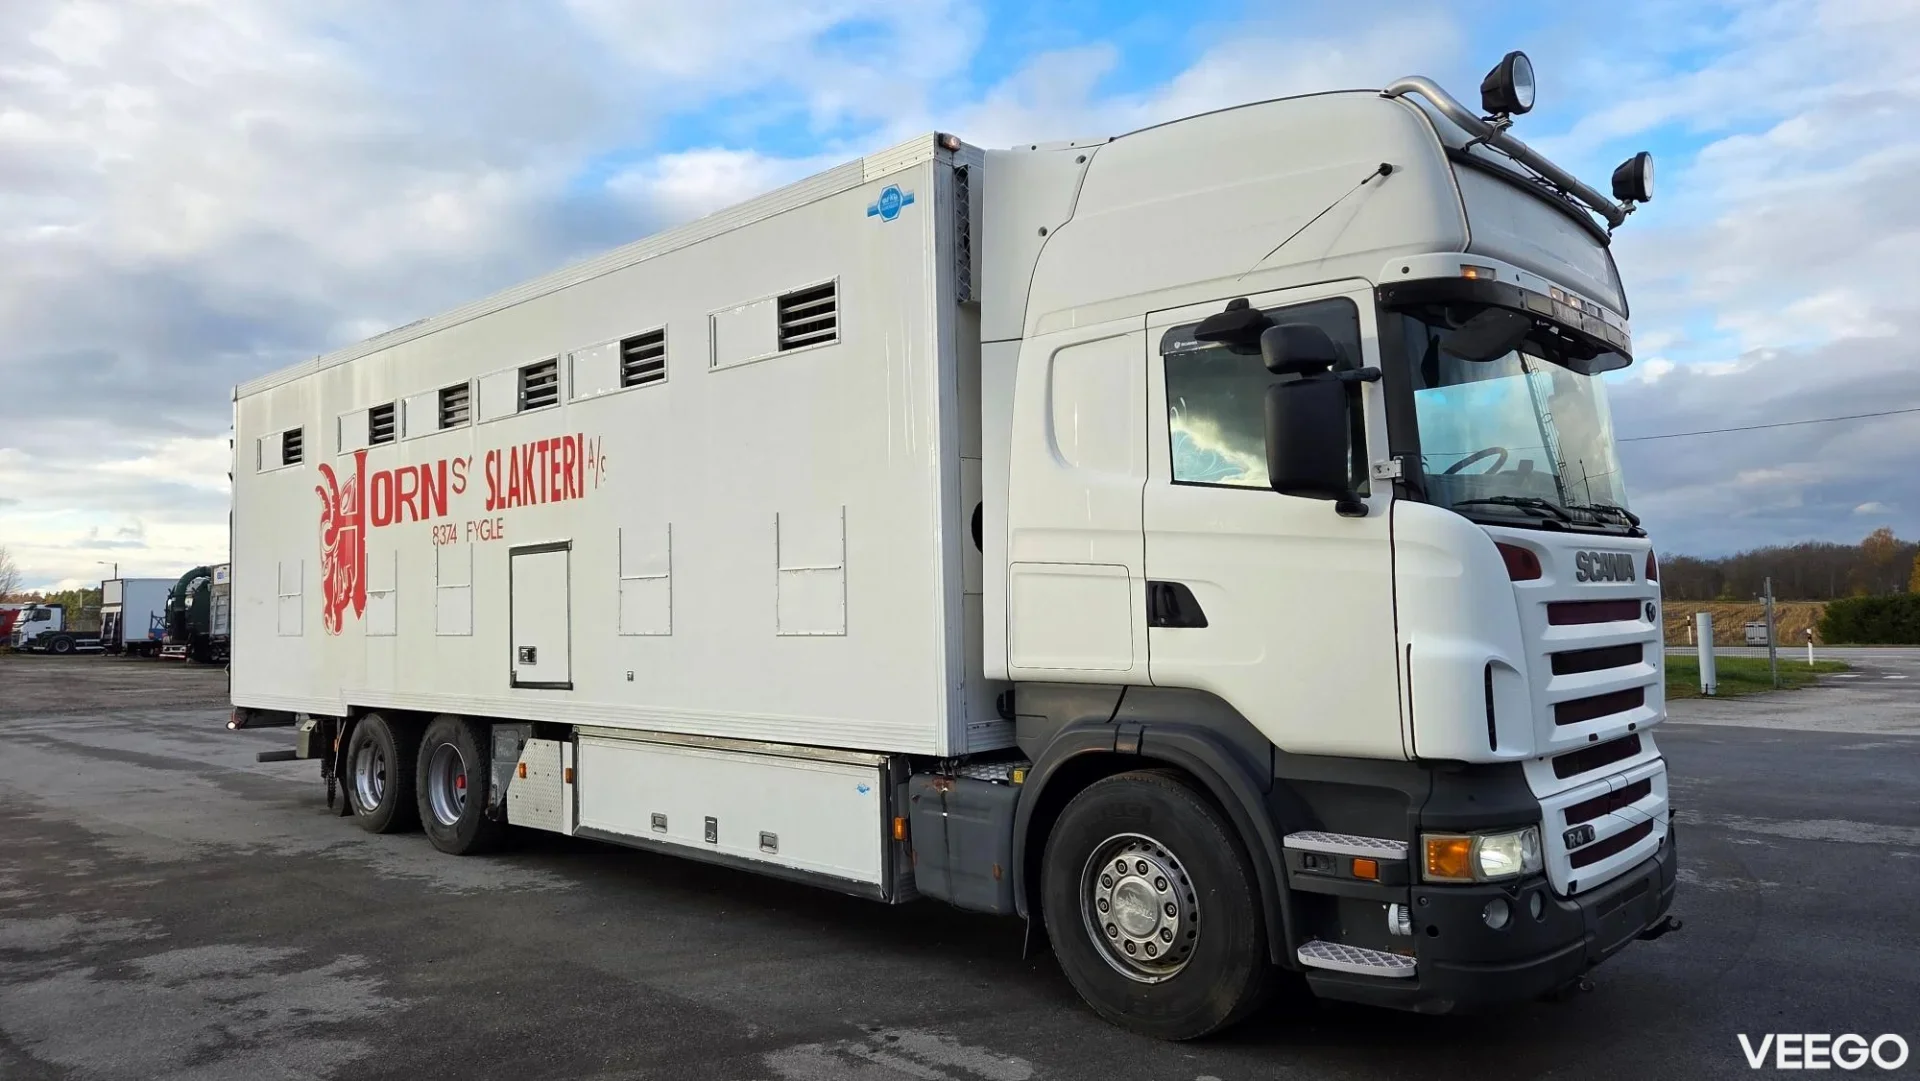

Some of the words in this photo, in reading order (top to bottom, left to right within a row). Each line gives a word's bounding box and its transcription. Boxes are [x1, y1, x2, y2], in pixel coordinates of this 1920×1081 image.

[485, 432, 584, 512] SLAKTERI
[432, 522, 458, 546] 8374
[466, 516, 504, 543] FYGLE
[1575, 550, 1636, 583] SCANIA
